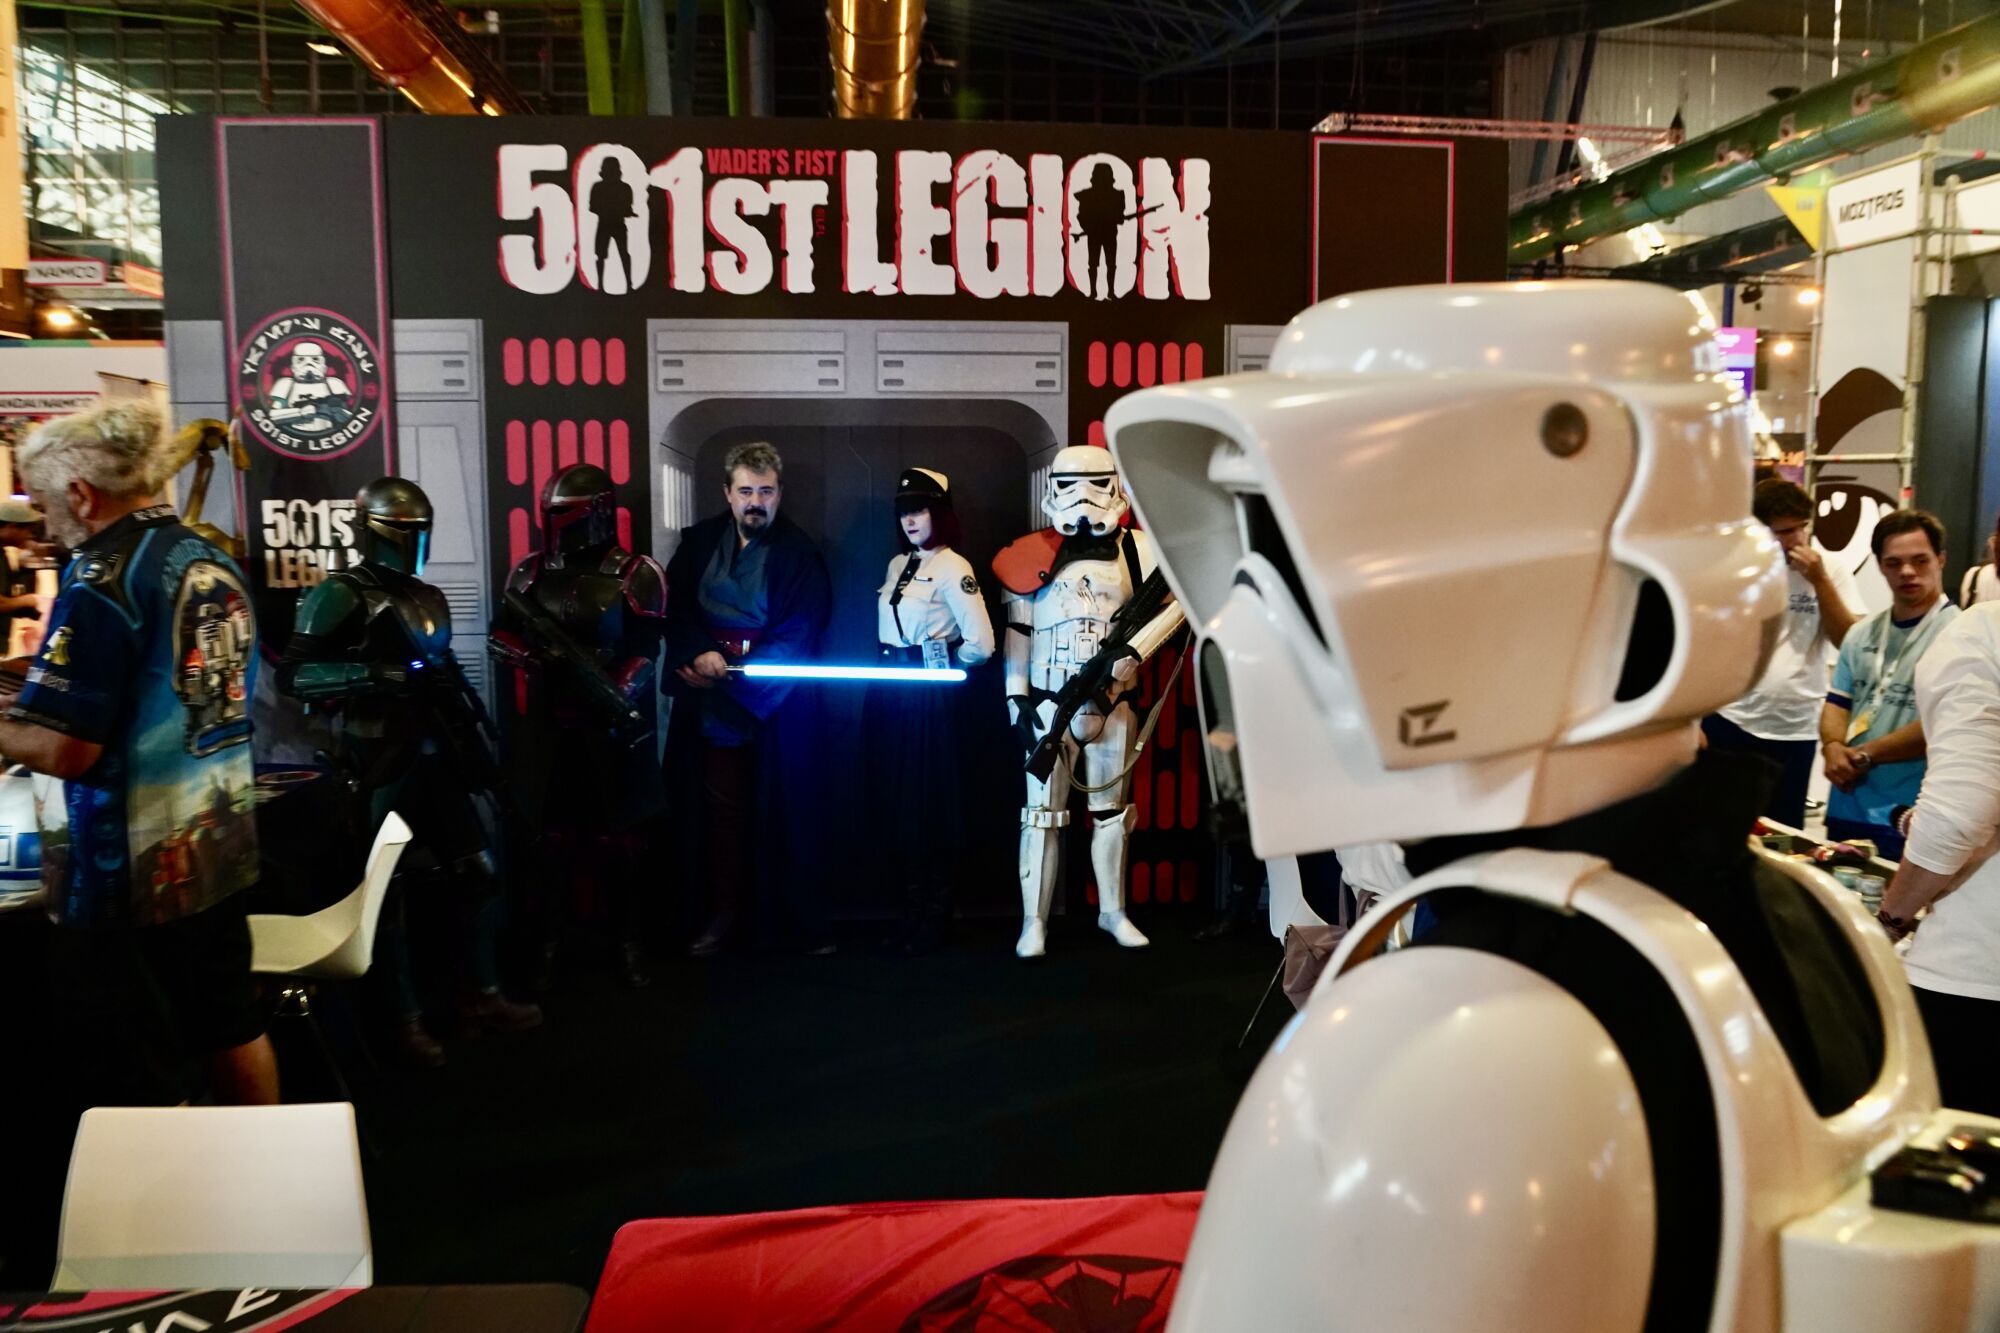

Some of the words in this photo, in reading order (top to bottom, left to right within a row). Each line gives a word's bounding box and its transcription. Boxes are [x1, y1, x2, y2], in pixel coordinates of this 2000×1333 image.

[706, 148, 790, 176] VADER'S
[795, 149, 836, 176] FIST
[497, 143, 829, 295] 501ST
[841, 149, 1211, 301] LEGION
[1838, 189, 1905, 225] MOZTROS
[35, 265, 98, 279] NAMCO
[251, 408, 303, 449] 501ST
[308, 406, 373, 451] LEGION
[261, 498, 357, 548] 501S
